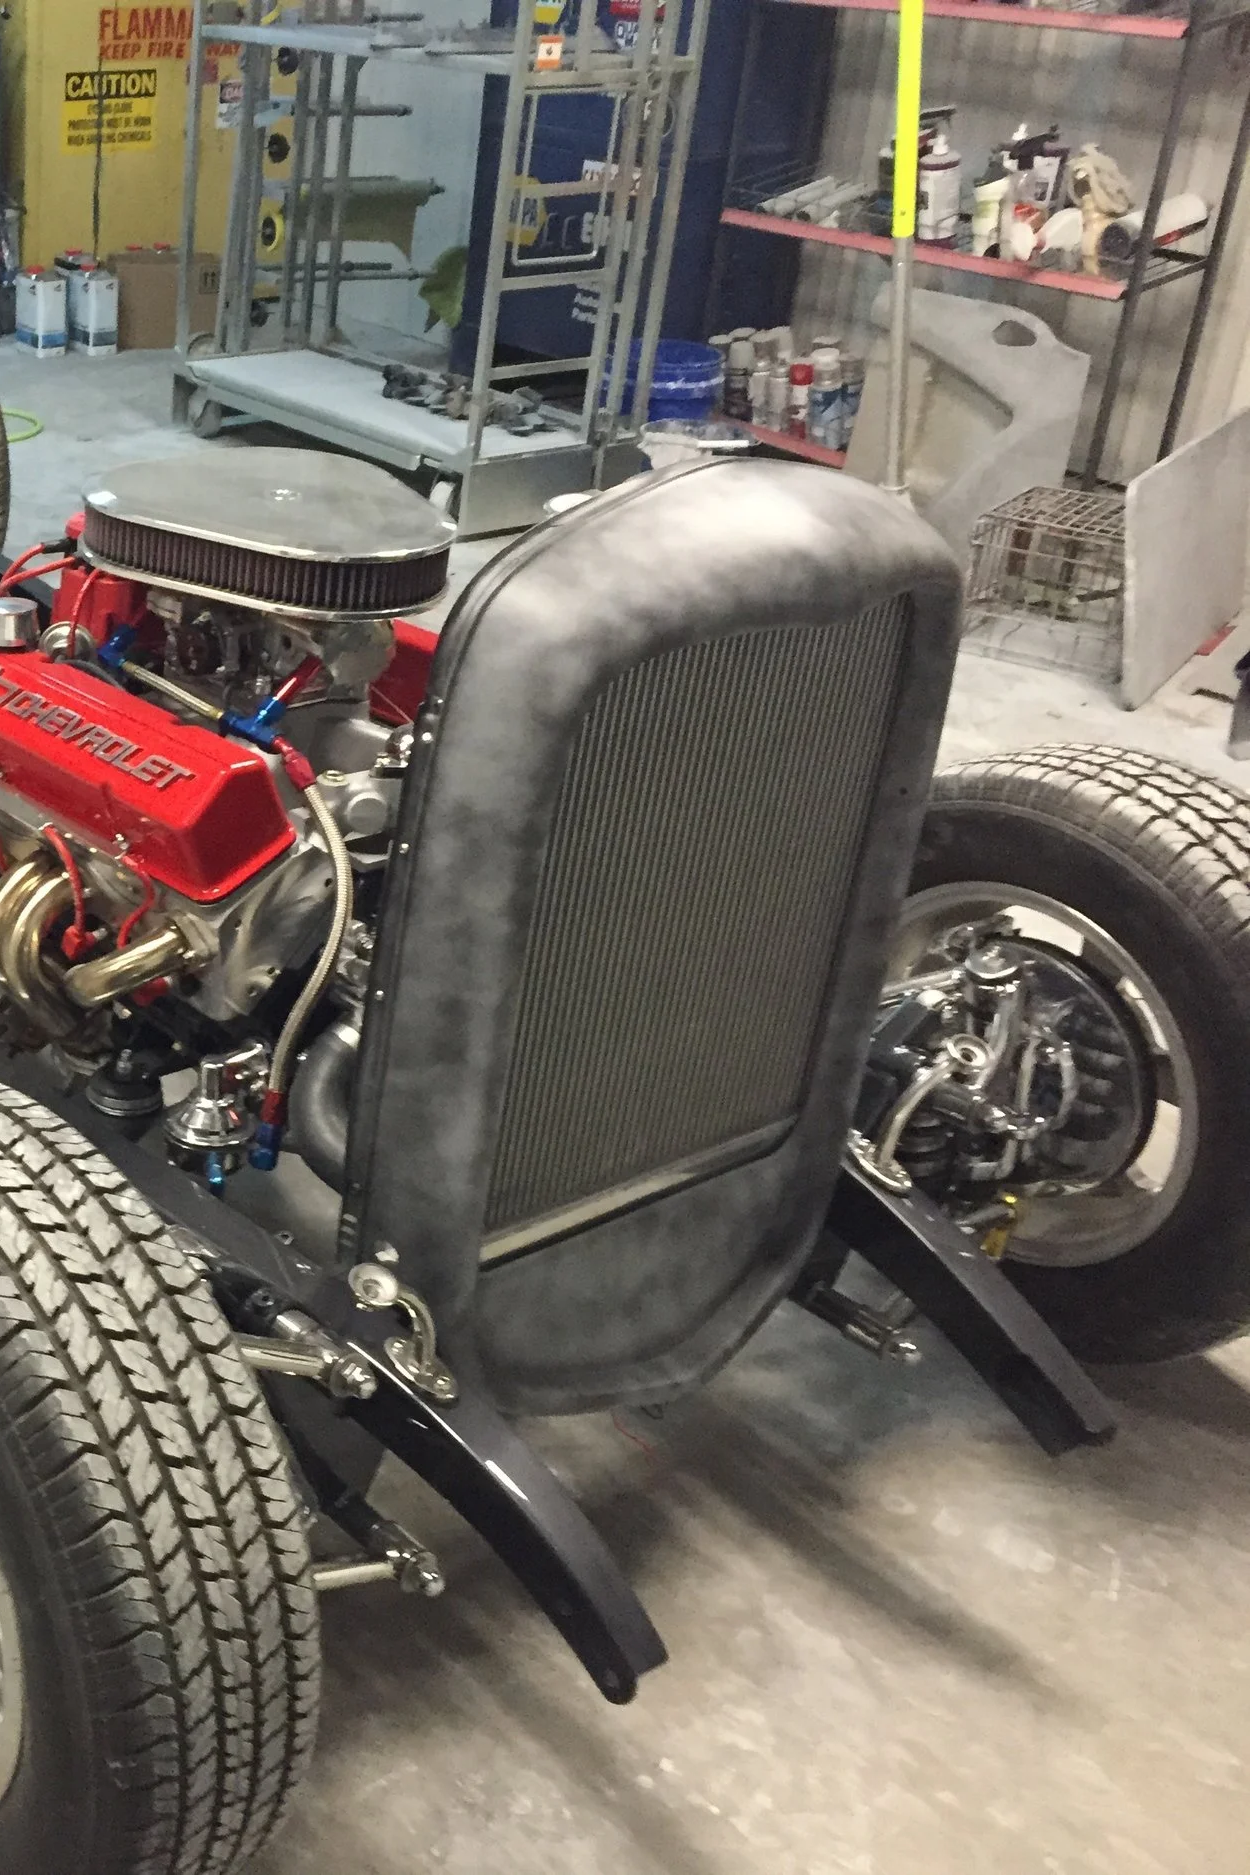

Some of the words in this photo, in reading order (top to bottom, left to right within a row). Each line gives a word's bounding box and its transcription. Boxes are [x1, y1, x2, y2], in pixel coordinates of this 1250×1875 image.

[100, 7, 194, 41] FLAMM
[100, 43, 141, 60] KEEP
[147, 41, 186, 59] FIRE
[206, 43, 242, 57] WAY
[67, 71, 155, 98] CAUTION
[6, 688, 193, 788] CHEVROLET
